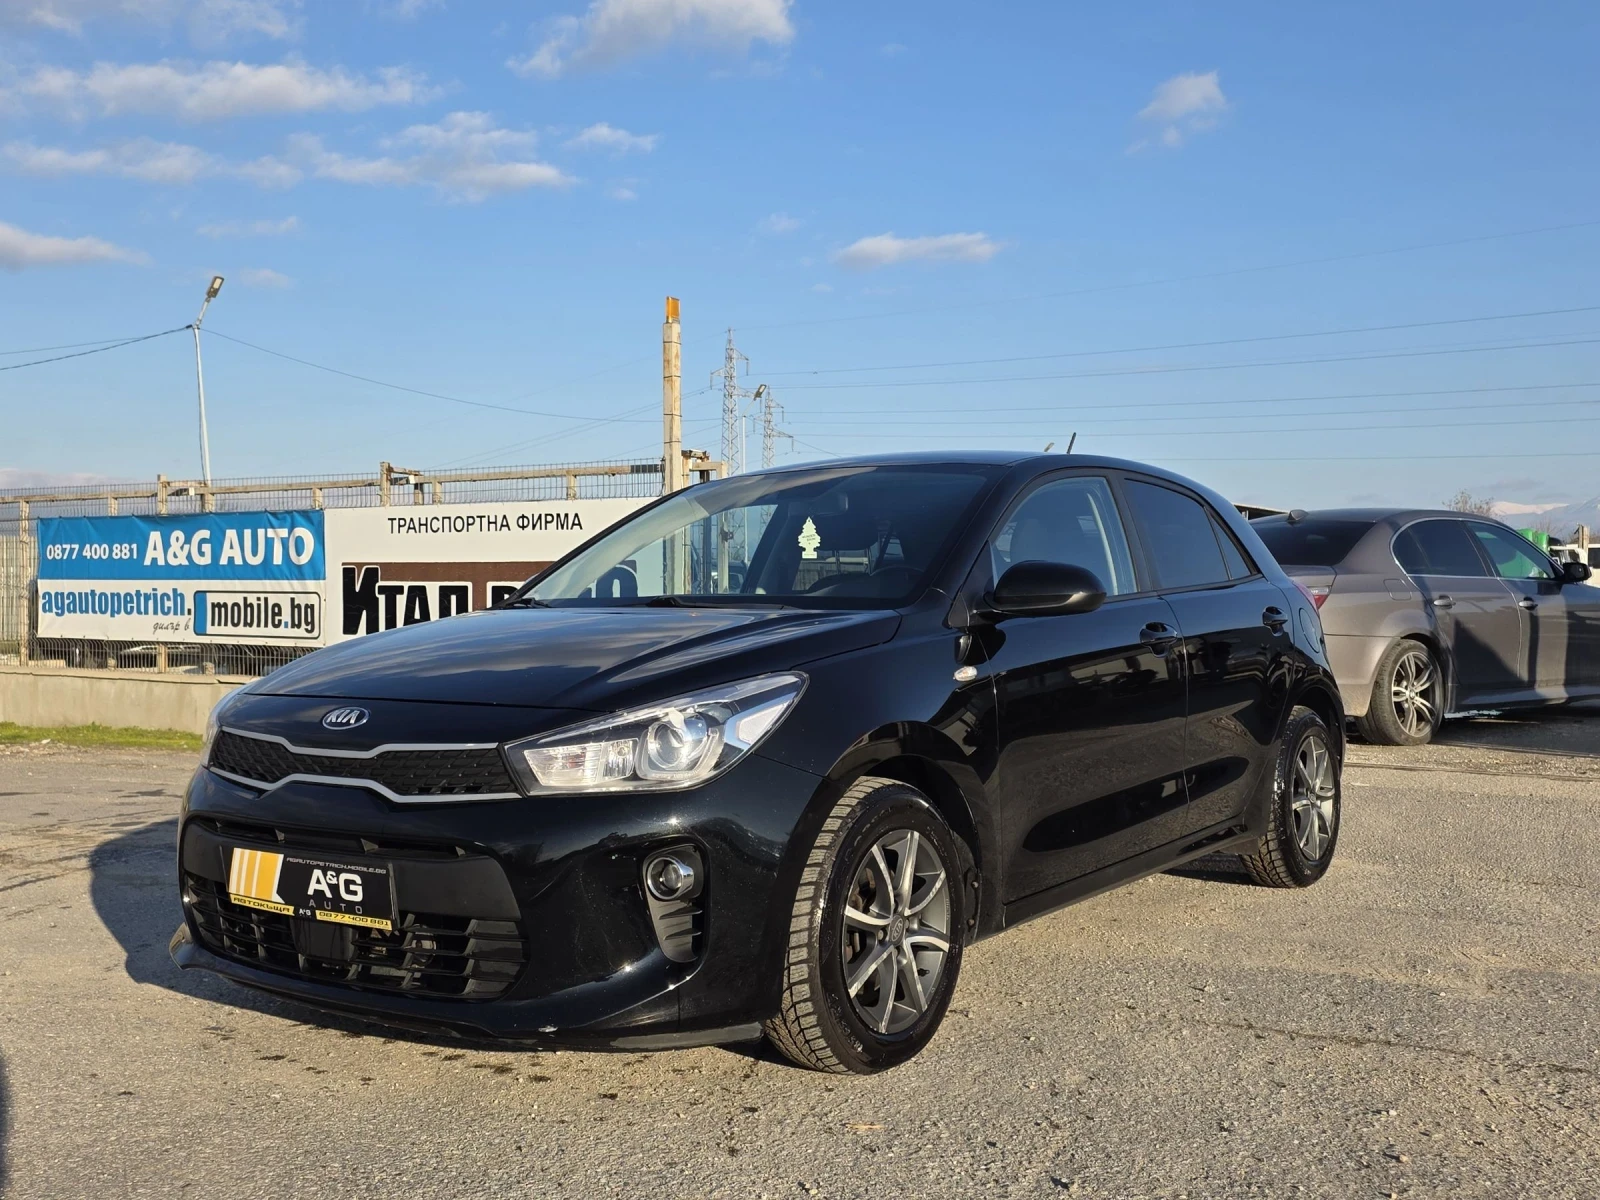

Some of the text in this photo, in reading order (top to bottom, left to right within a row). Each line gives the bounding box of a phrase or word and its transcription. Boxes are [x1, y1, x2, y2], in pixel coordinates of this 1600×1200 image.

[388, 512, 583, 534] ТРАНСПОРТНА ФИРМА
[46, 543, 138, 560] 0877 400 881
[144, 527, 315, 566] A&G AUTO
[211, 596, 315, 634] mobile.bg
[326, 709, 360, 724] KIA
[307, 868, 363, 902] A&G
[309, 899, 363, 914] AUTO
[319, 911, 346, 919] 0877
